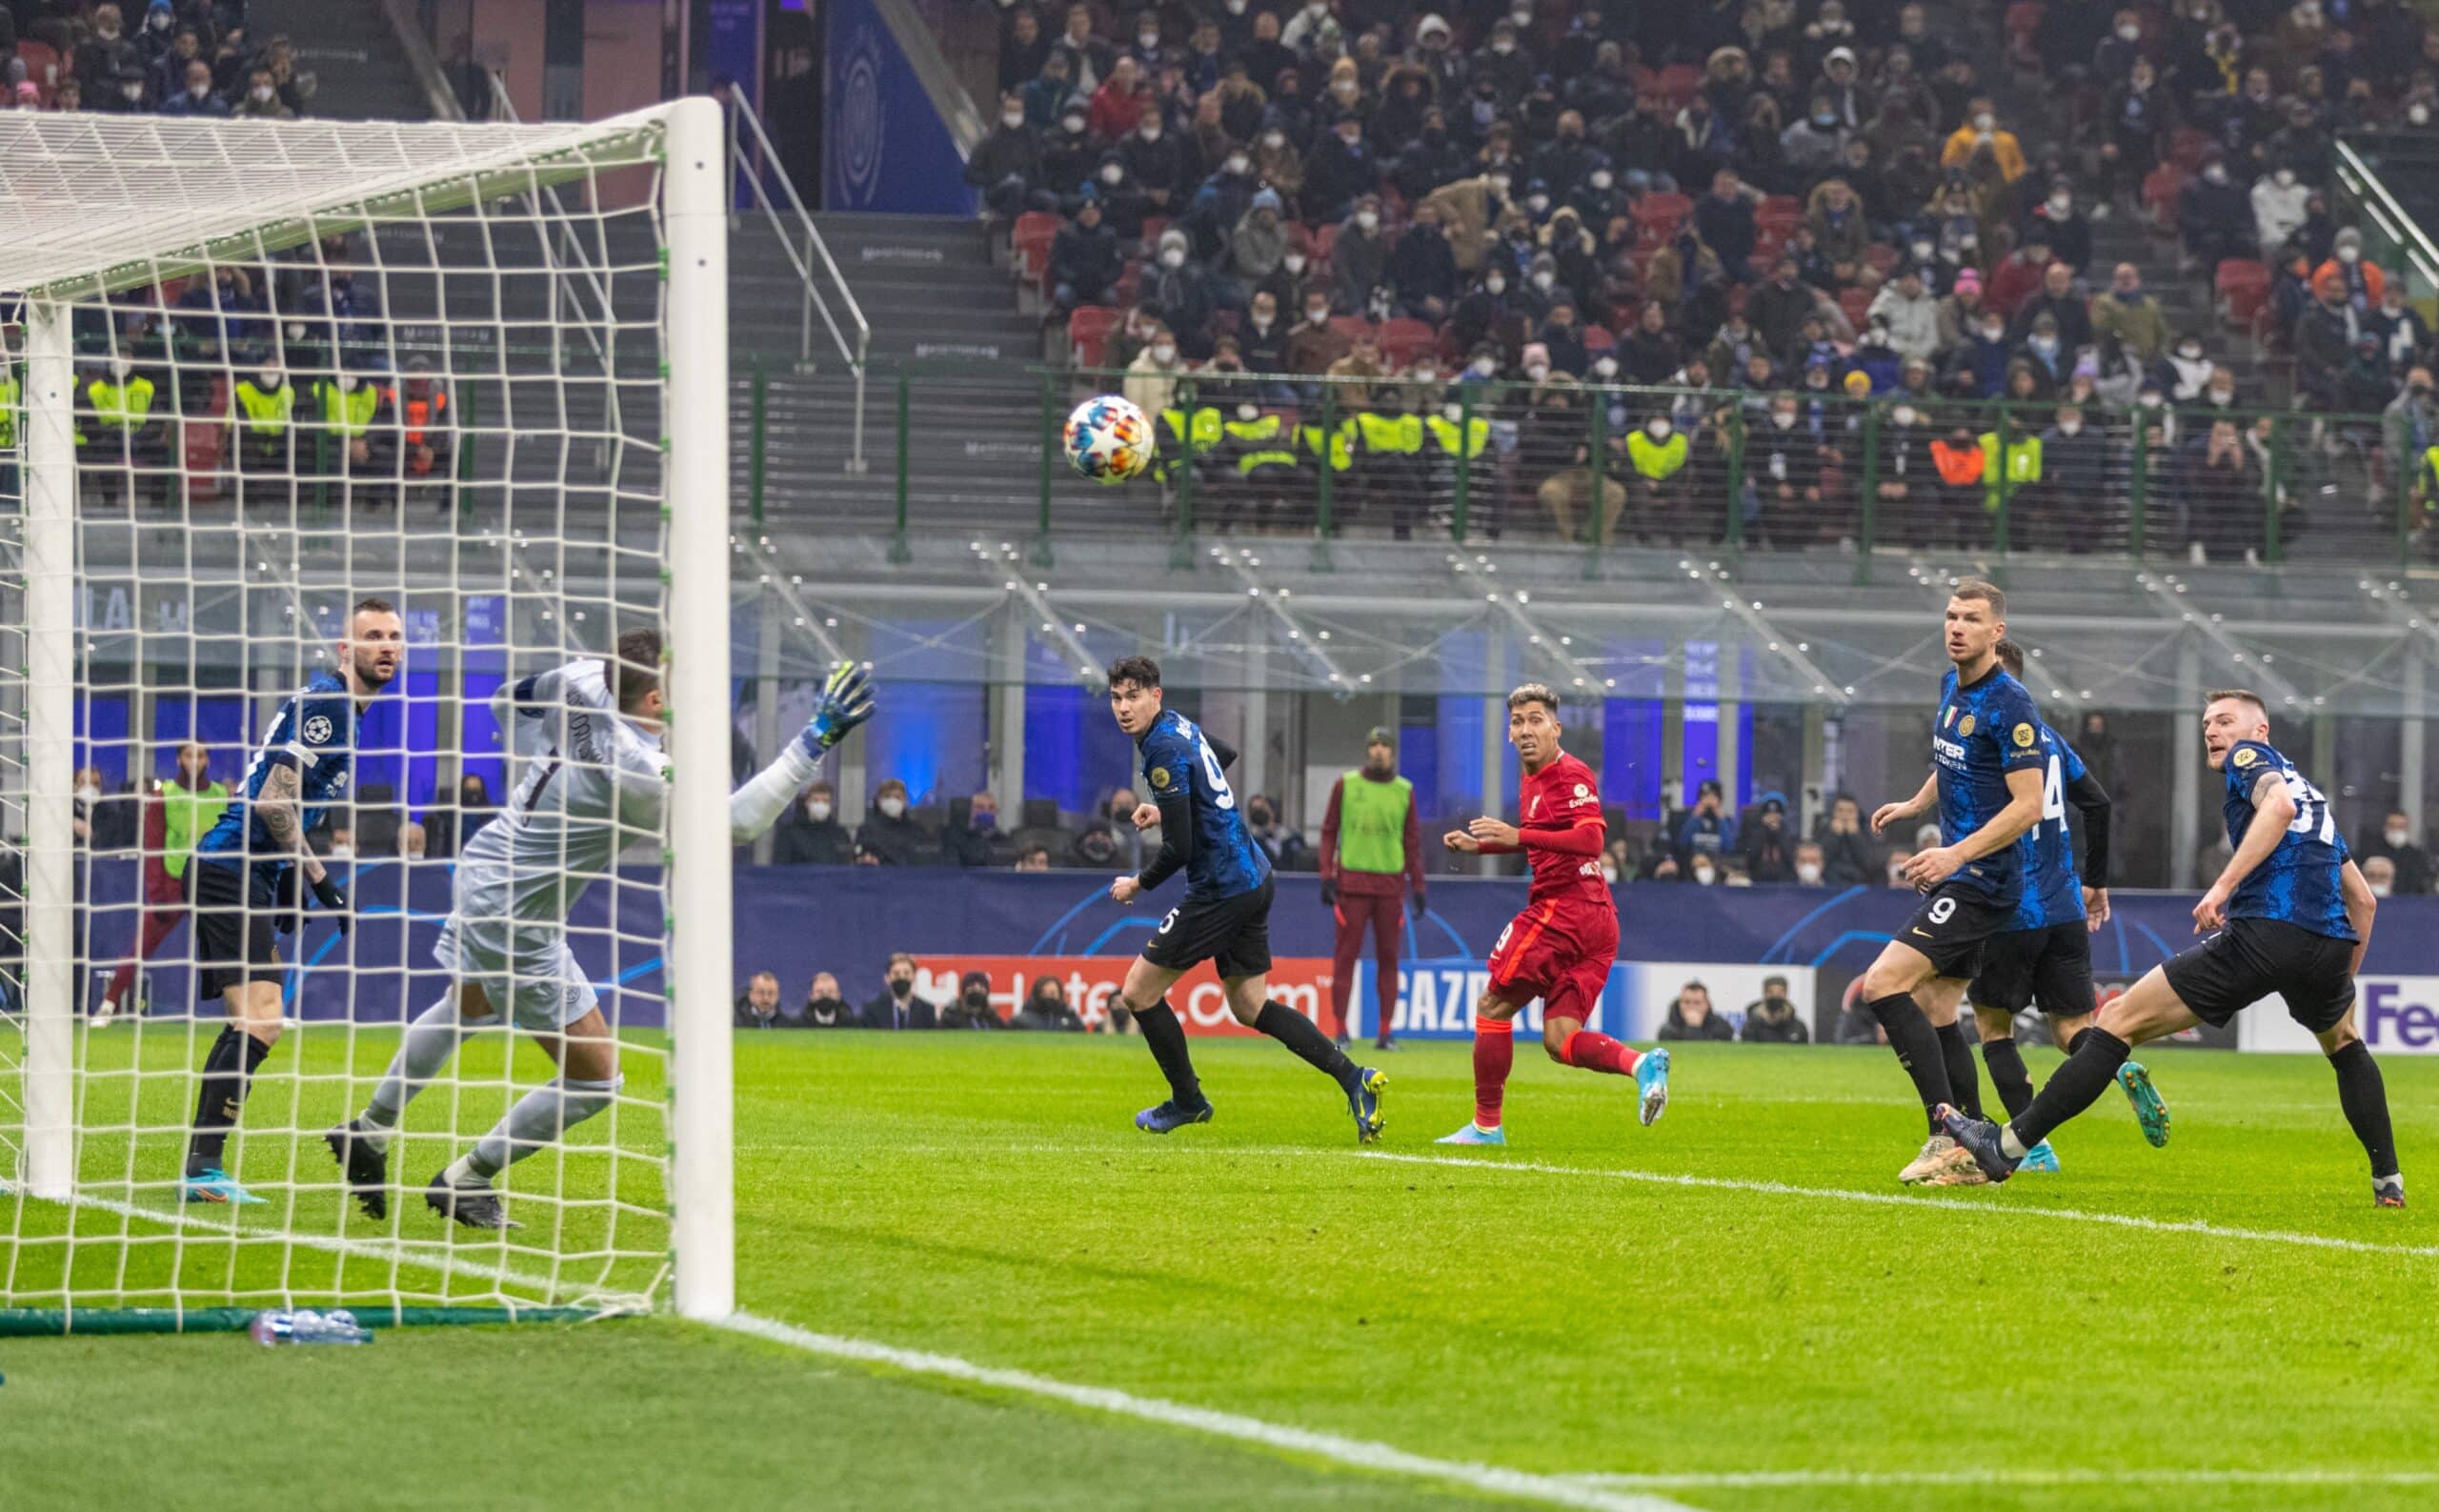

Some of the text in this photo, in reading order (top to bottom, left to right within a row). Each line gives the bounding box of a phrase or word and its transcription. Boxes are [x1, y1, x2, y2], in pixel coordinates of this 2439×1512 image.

[2032, 755, 2068, 840] 4
[1158, 907, 1180, 935] 5
[1928, 897, 1956, 924] 9
[1495, 921, 1514, 953] 9
[1390, 969, 1602, 1031] GAZP
[2367, 984, 2439, 1046] Fe
